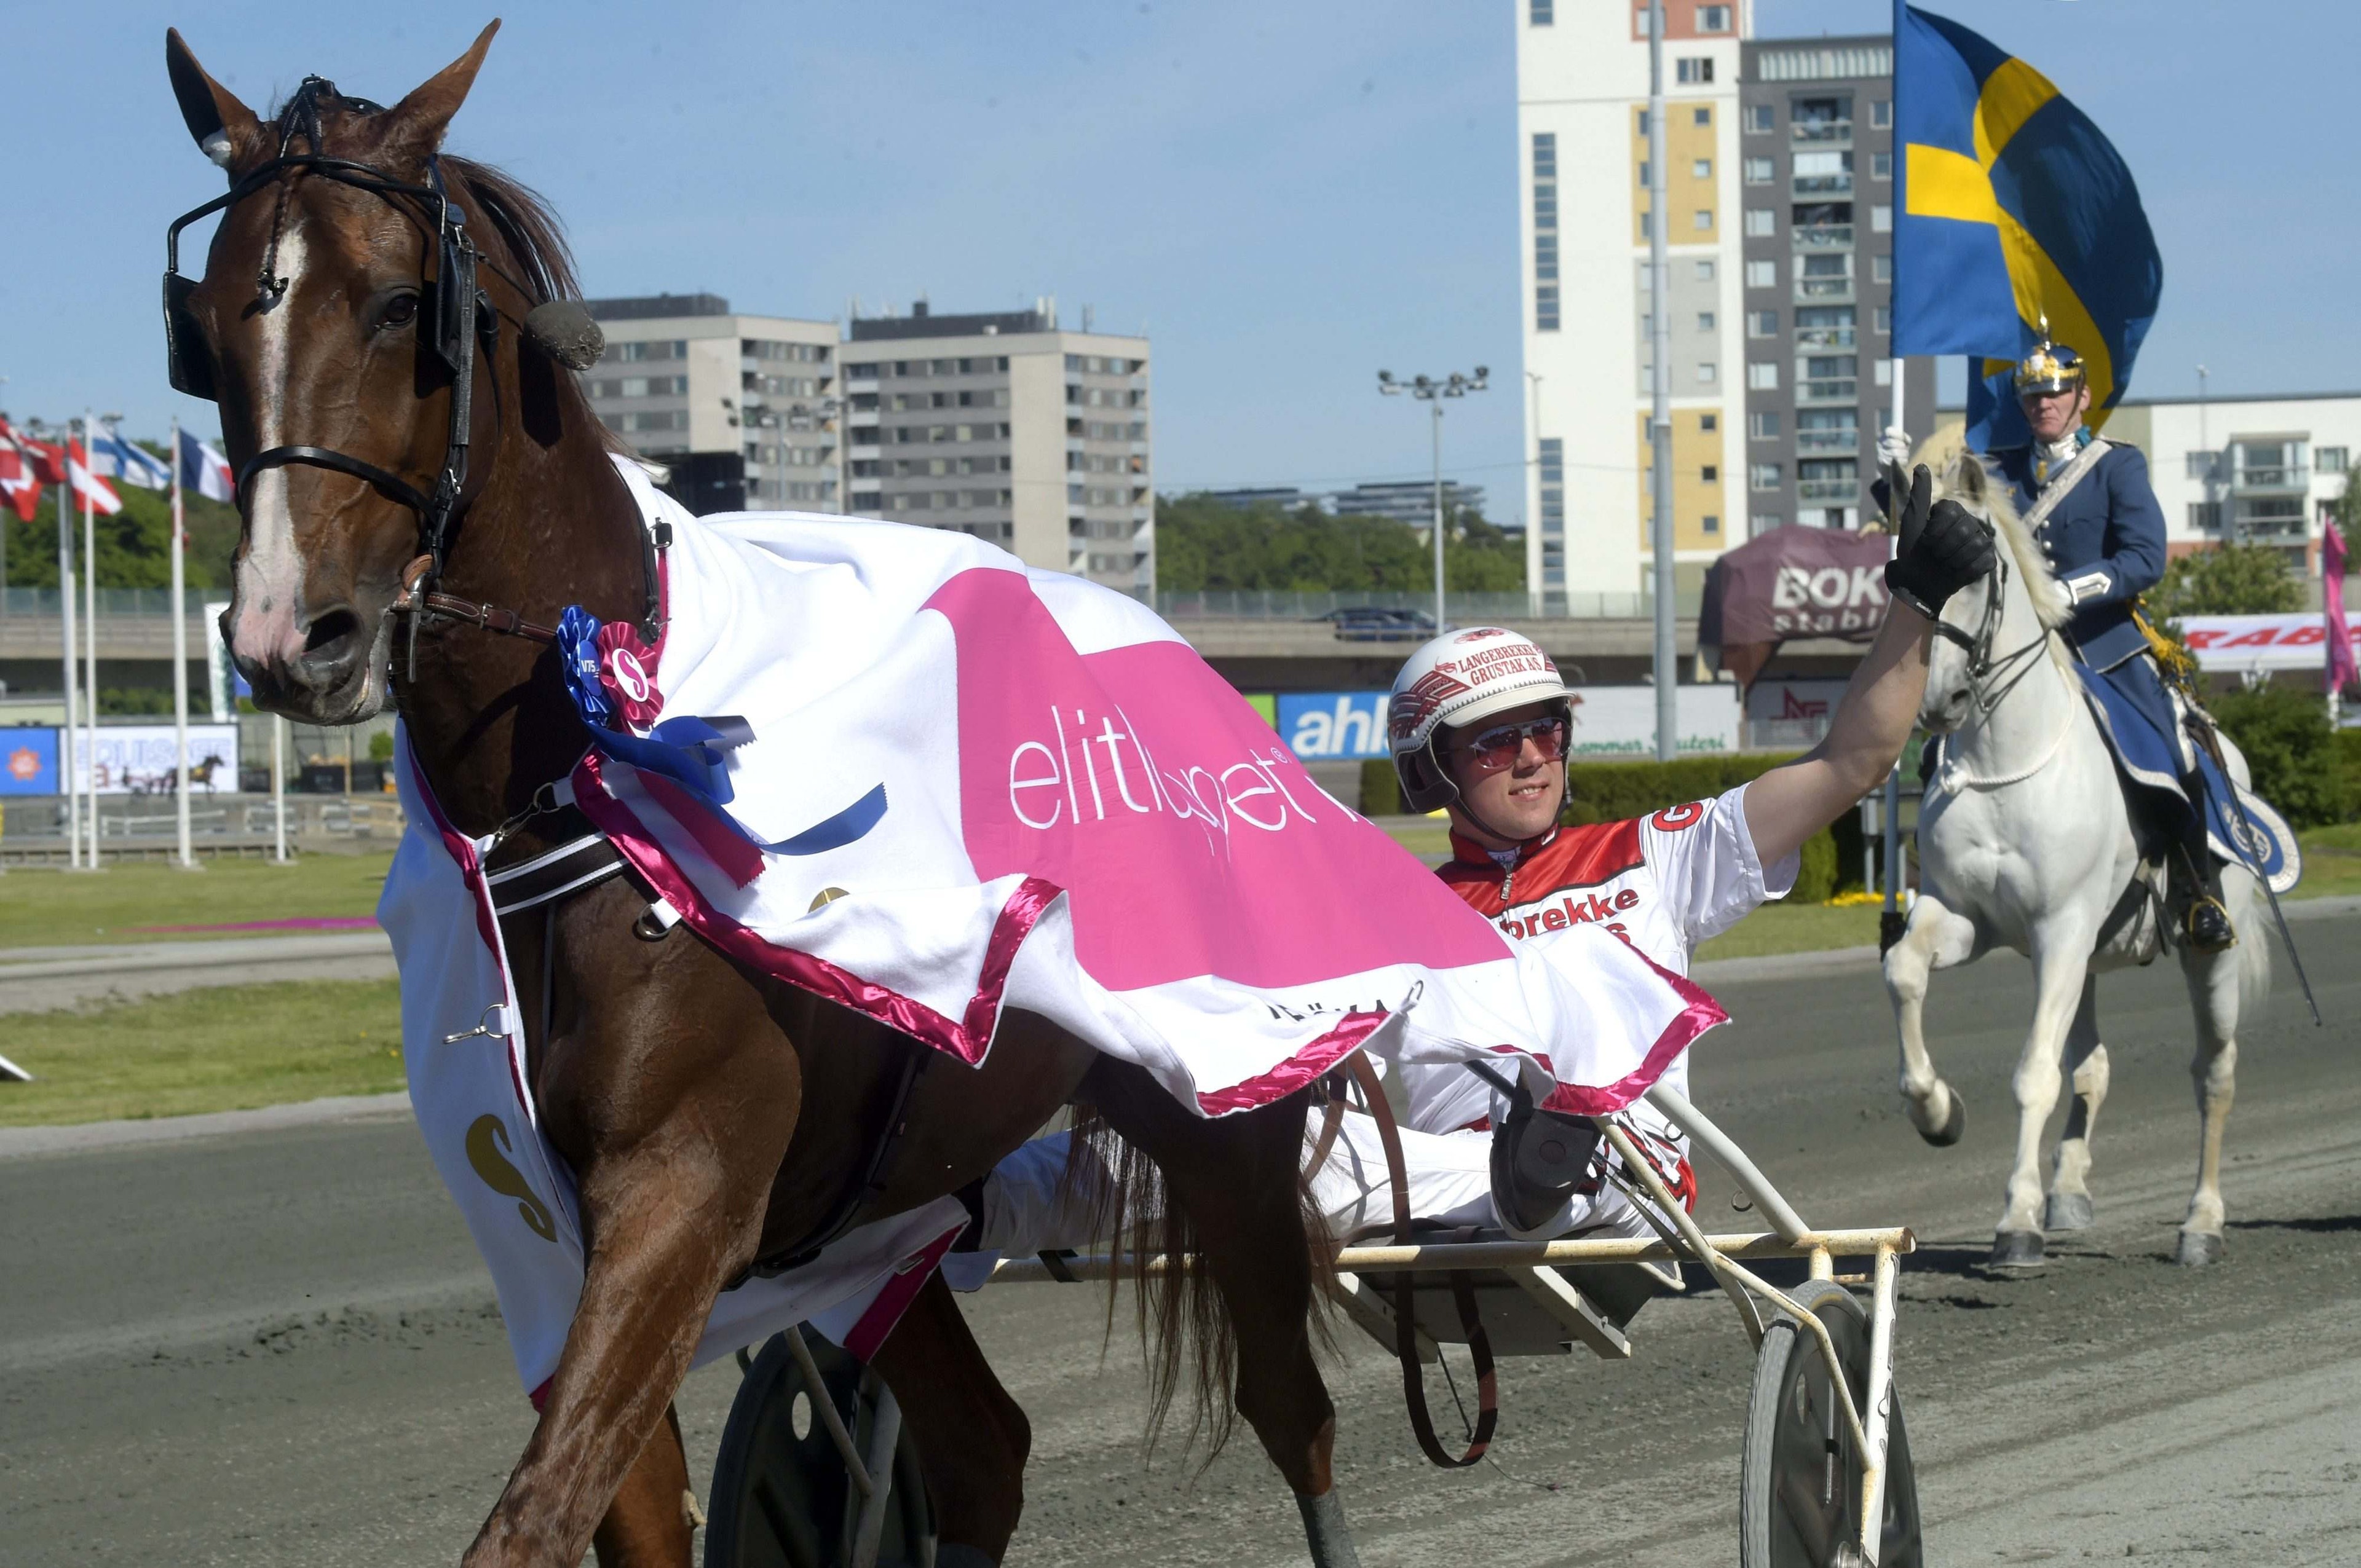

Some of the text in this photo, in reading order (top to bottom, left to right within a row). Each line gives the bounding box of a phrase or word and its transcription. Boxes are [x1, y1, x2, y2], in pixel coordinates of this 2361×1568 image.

[1774, 607, 1884, 632] stabl
[581, 660, 596, 673] V75
[1470, 661, 1527, 686] GRUSTAK
[1292, 695, 1390, 755] ahl
